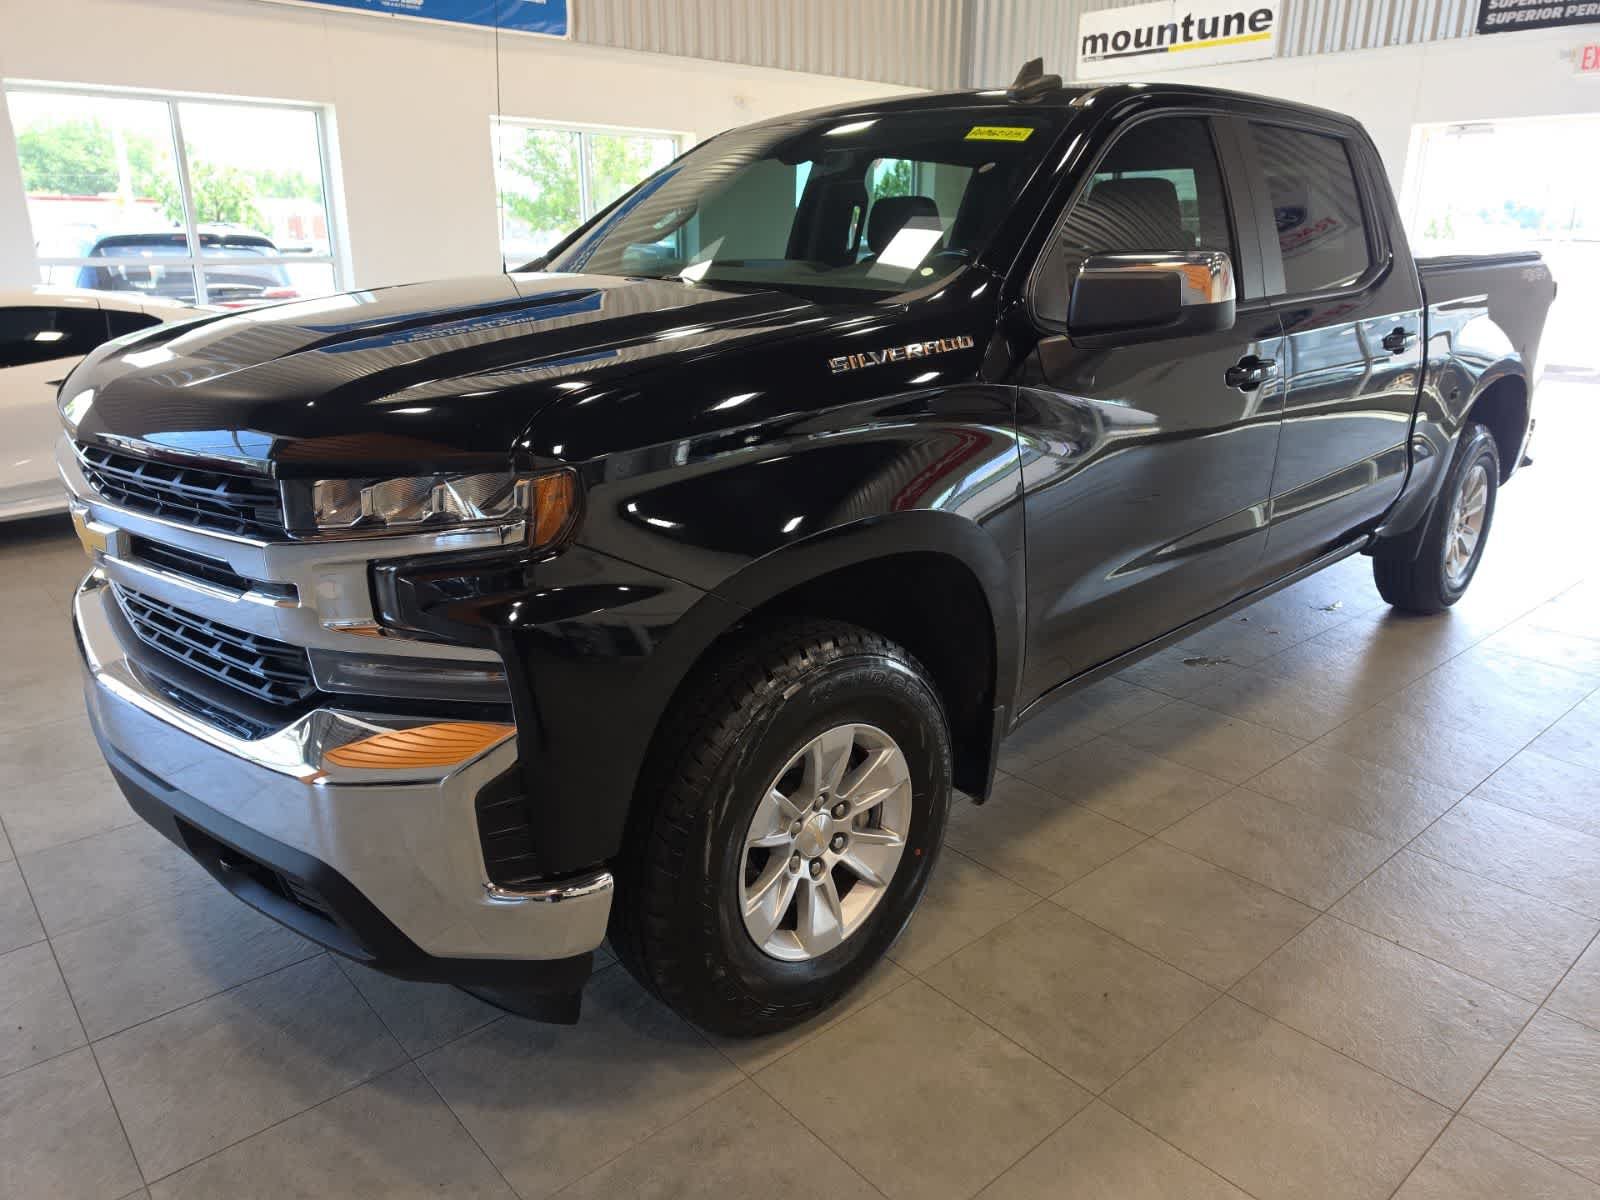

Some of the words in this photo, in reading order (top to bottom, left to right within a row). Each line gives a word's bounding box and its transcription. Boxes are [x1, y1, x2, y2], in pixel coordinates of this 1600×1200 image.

[1082, 8, 1273, 55] mountune
[1485, 6, 1565, 25] SUPERIOR
[1565, 3, 1600, 17] PER
[829, 335, 975, 373] SILVERADO
